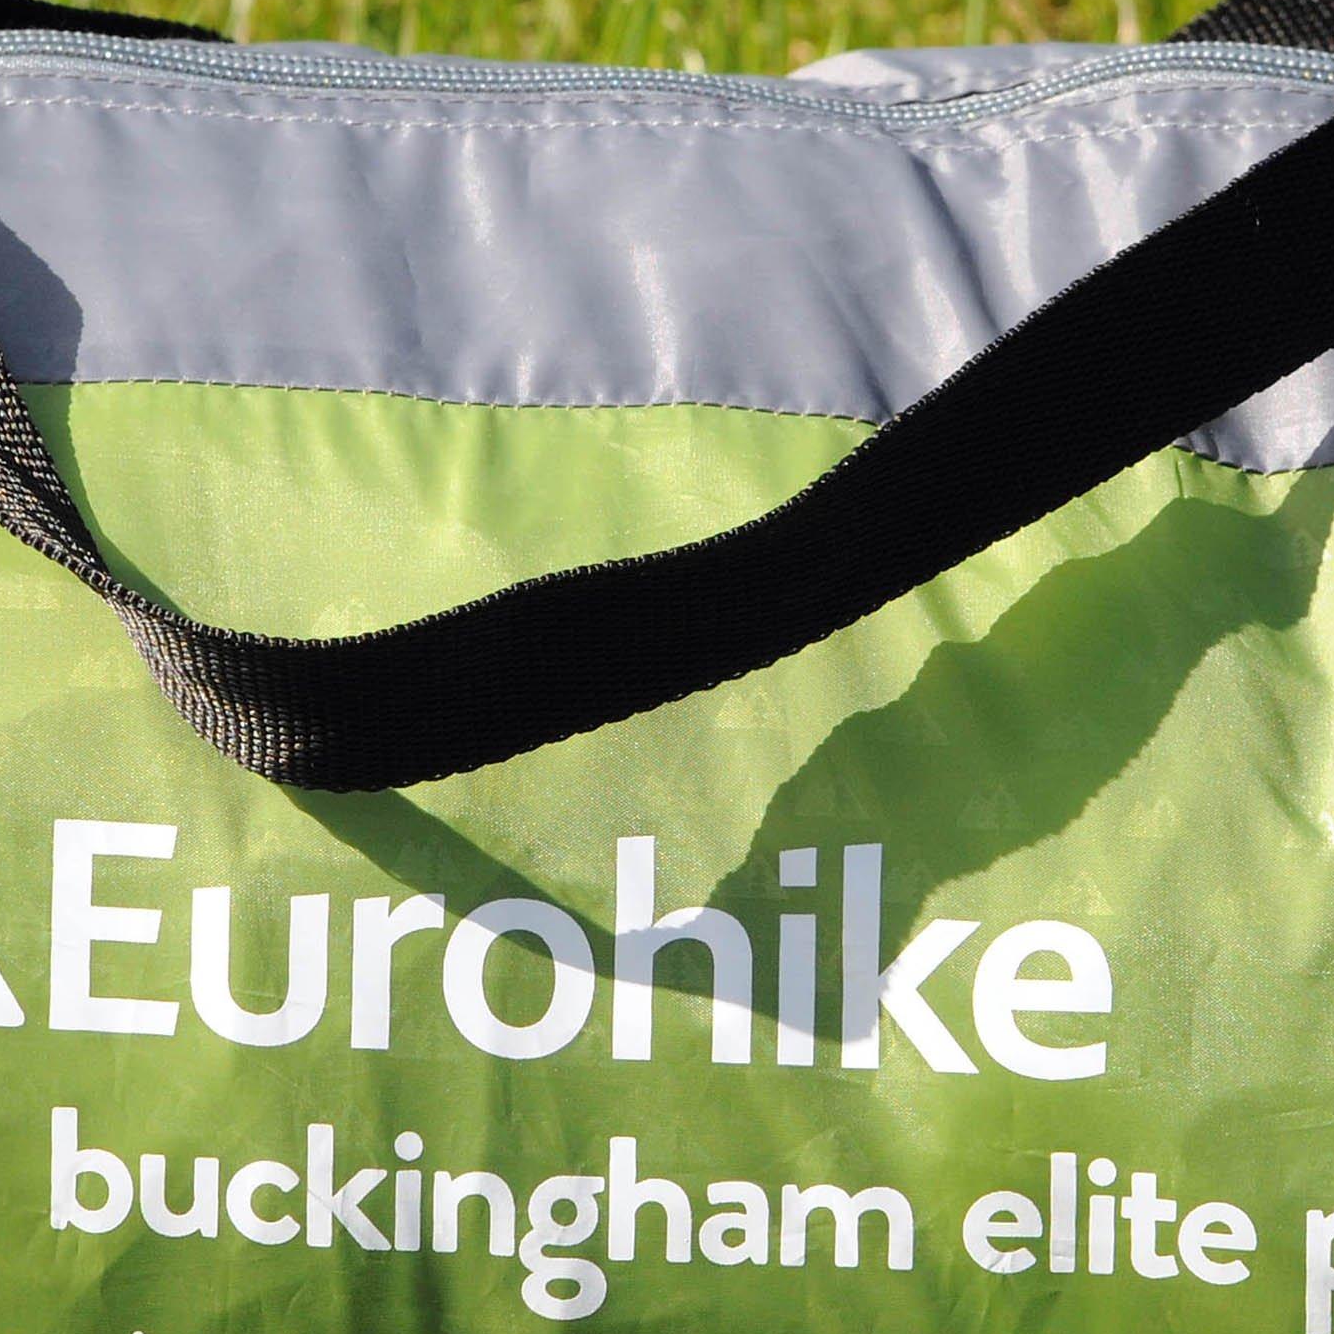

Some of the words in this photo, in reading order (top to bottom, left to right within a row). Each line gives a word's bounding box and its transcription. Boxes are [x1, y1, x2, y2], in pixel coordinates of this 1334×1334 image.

[48, 816, 1114, 1081] Eurohike
[50, 1106, 915, 1321] buckingham
[962, 1151, 1258, 1286] elite
